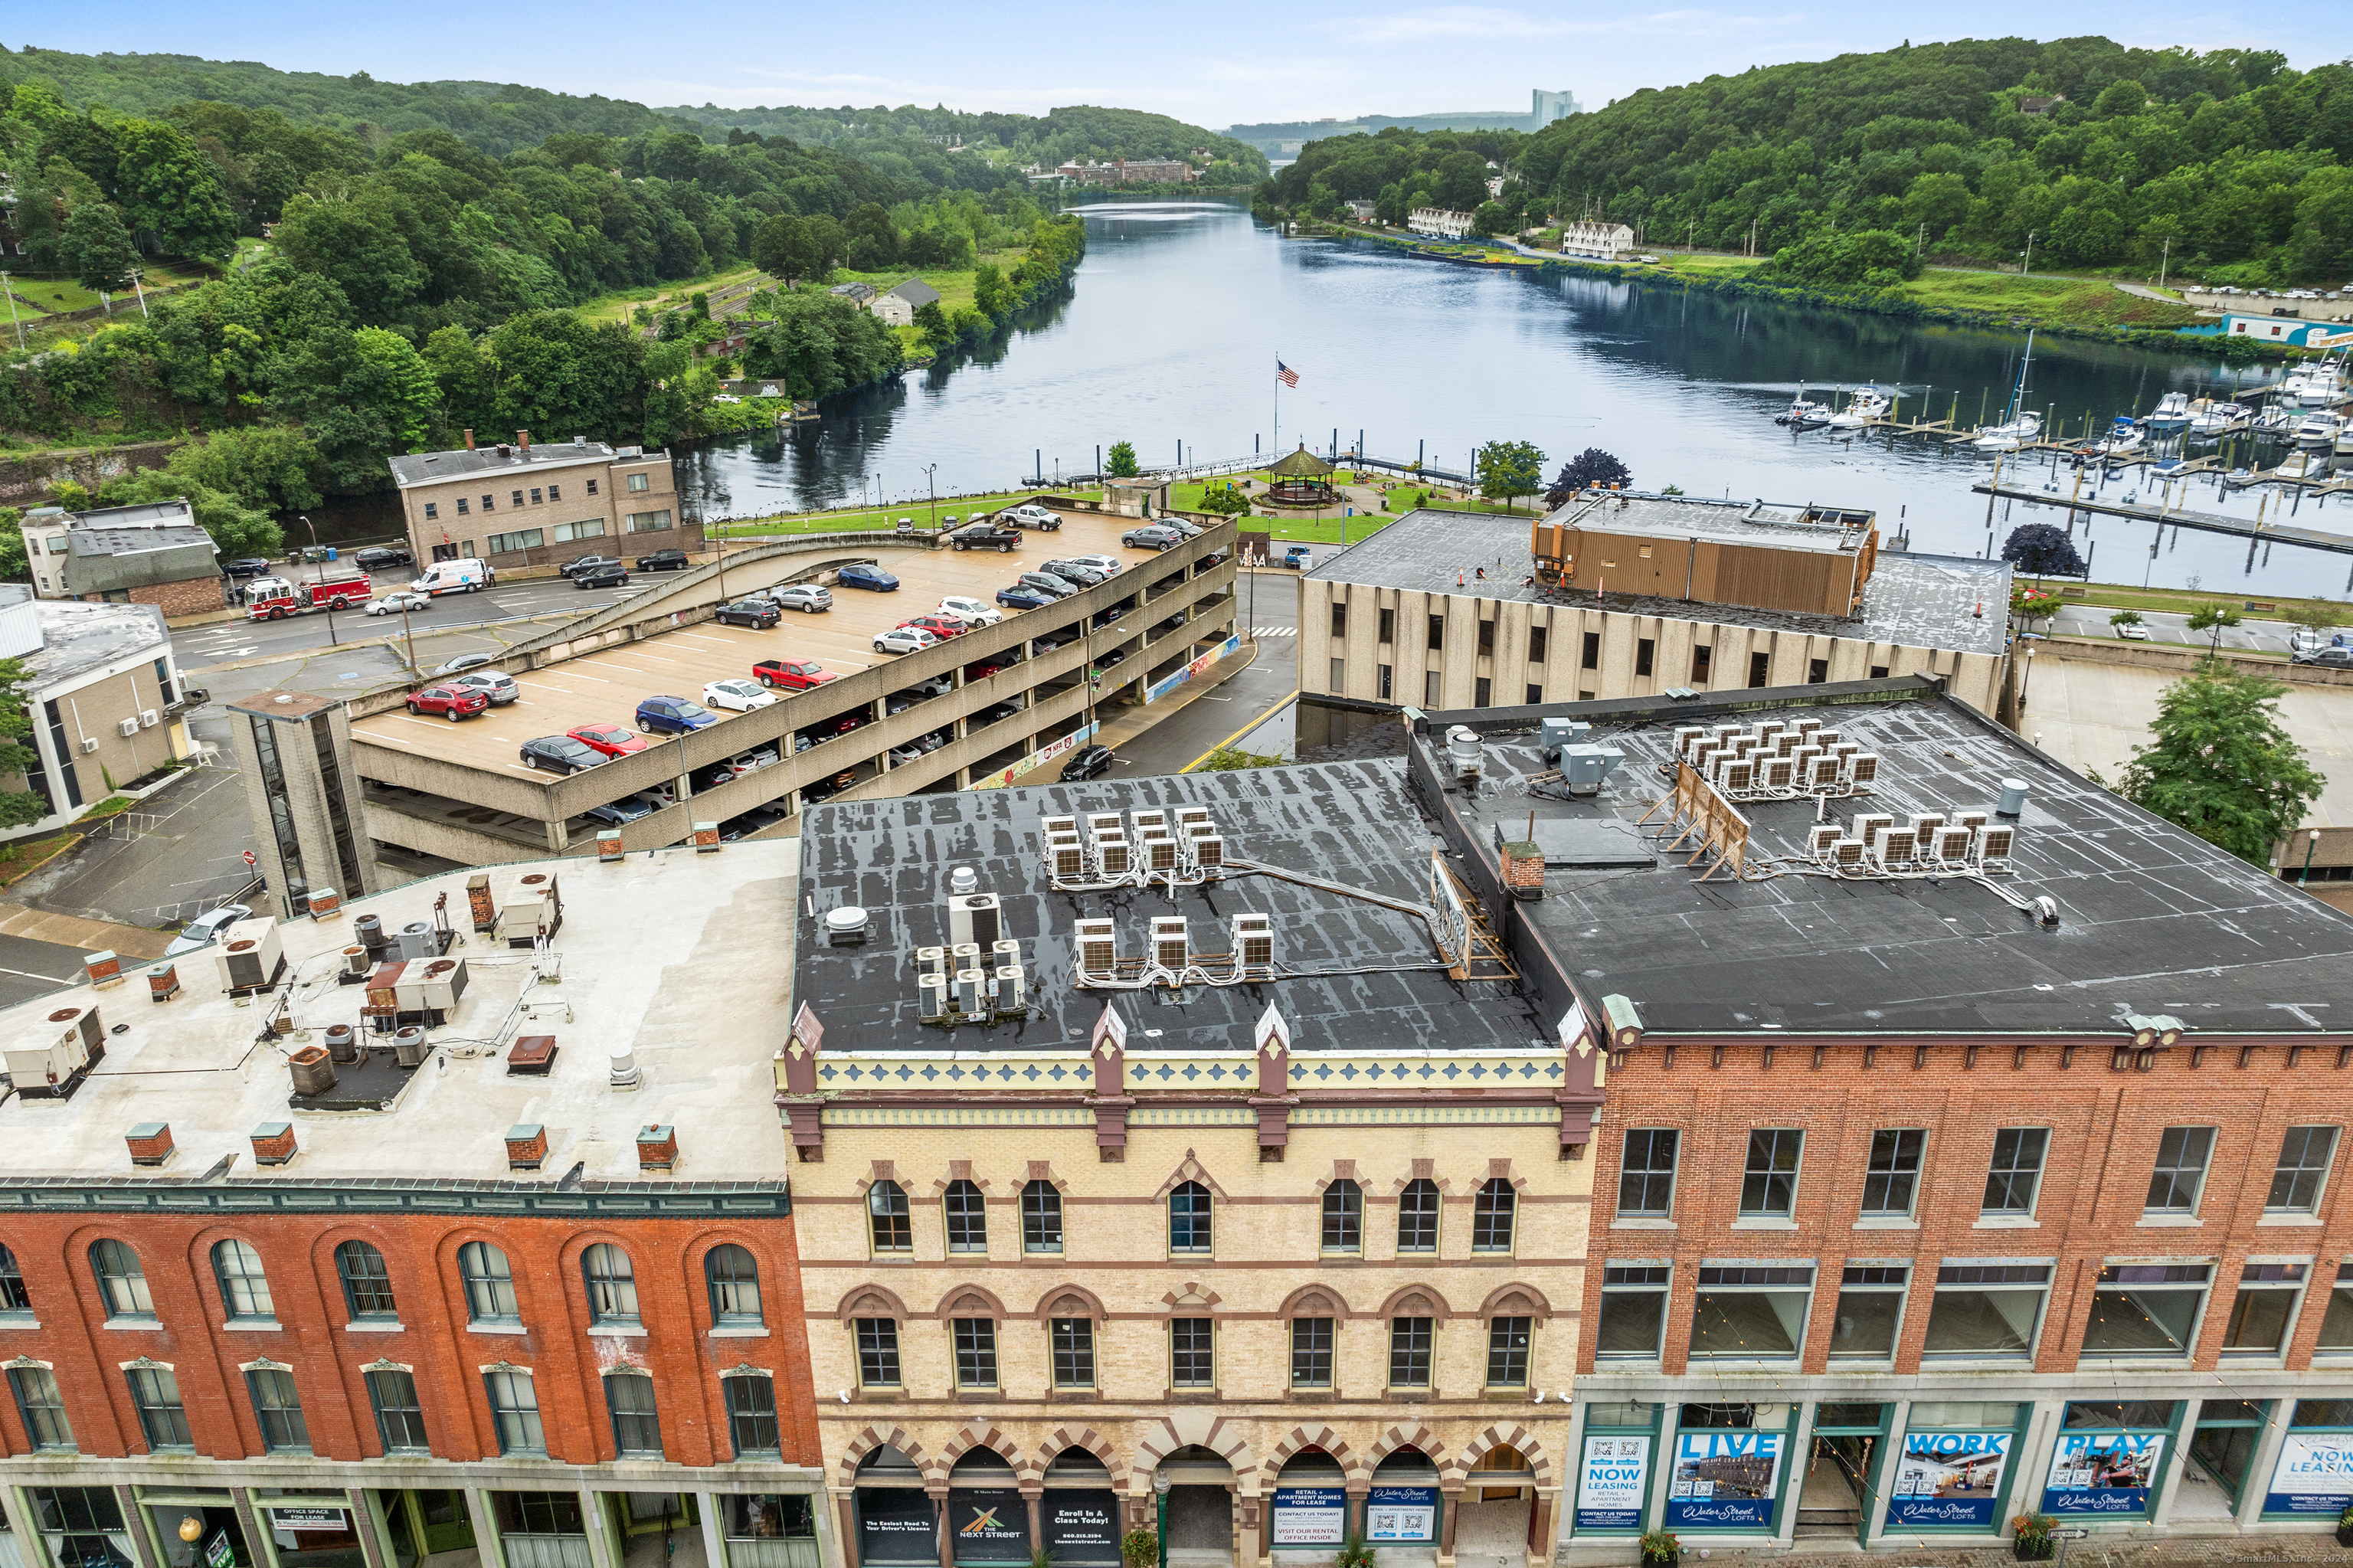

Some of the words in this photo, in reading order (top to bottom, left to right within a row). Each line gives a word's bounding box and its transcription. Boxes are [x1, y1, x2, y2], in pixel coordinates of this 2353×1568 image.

[1052, 742, 1062, 752] NFA
[1680, 1435, 1777, 1458] LIVE
[1908, 1435, 2008, 1454] WORK
[2064, 1435, 2156, 1455] PLAY
[2290, 1462, 2353, 1472] LEASIN
[1589, 1469, 1641, 1480] NOW
[1374, 1488, 1402, 1498] Water
[1401, 1488, 1427, 1499] Street
[2057, 1494, 2096, 1507] Water
[2093, 1494, 2130, 1508] Street
[1683, 1505, 1720, 1517] Water
[1718, 1505, 1754, 1520] Street
[1903, 1504, 1941, 1516] Water
[1939, 1503, 1975, 1518] Street
